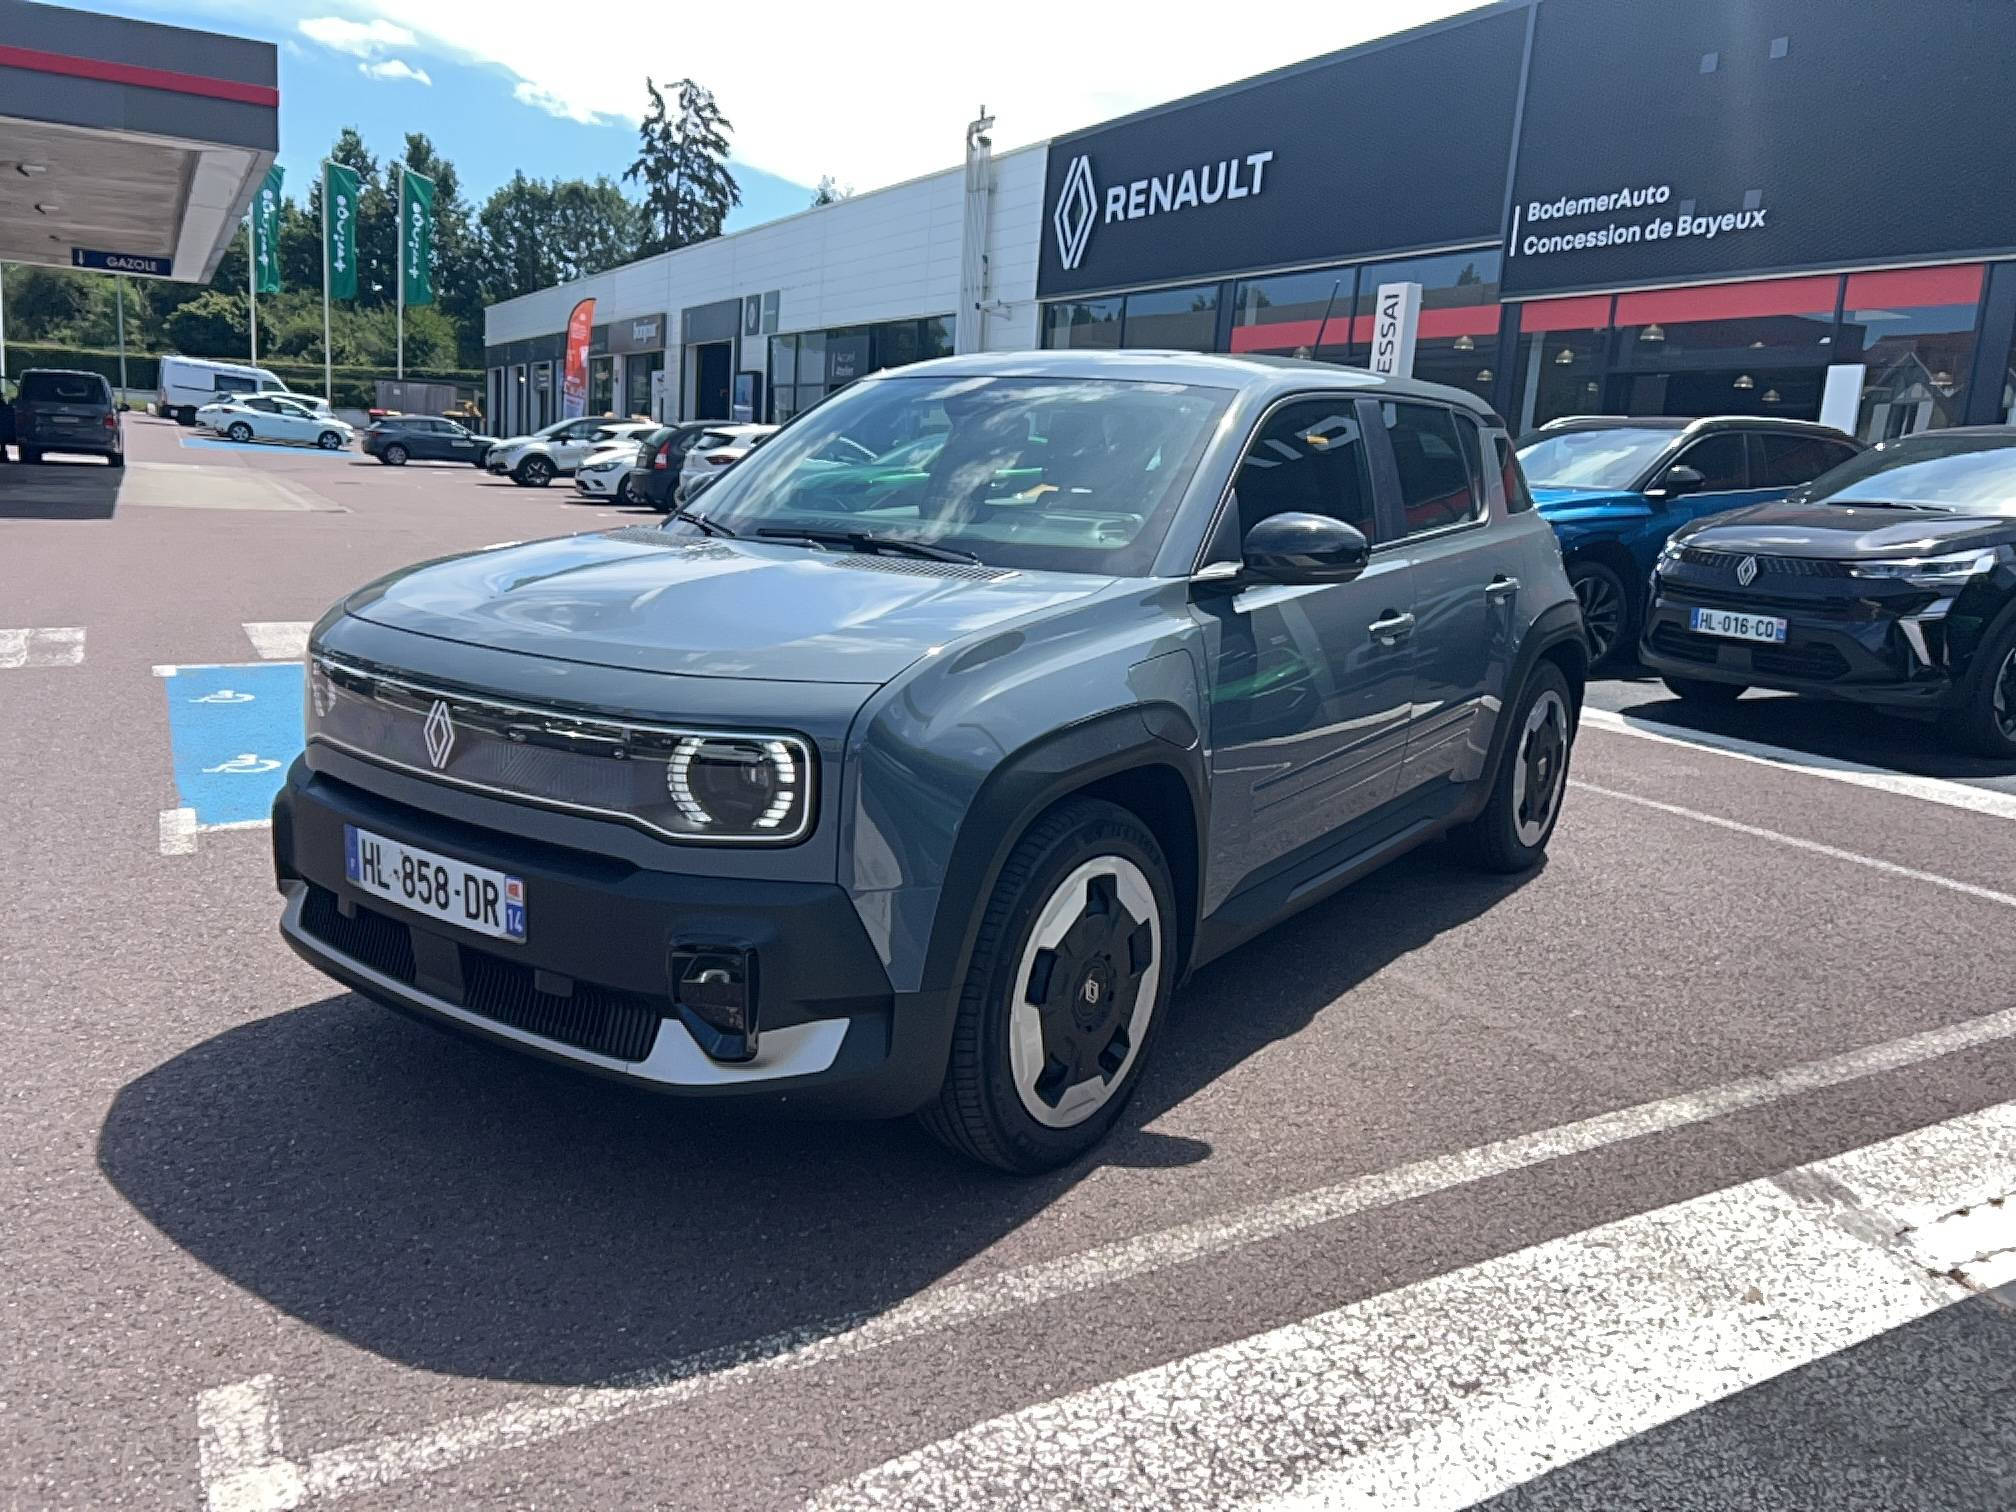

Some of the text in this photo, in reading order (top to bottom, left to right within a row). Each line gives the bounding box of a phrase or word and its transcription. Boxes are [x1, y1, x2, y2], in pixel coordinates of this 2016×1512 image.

[1104, 150, 1274, 224] RENAULT
[1527, 185, 1671, 222] BodemerAuto
[1523, 208, 1767, 256] Concession de Bayeux
[106, 256, 157, 272] GAZOLE
[1376, 294, 1400, 374] ESSAI
[361, 838, 500, 928] HL-858-DR
[507, 908, 523, 933] 14
